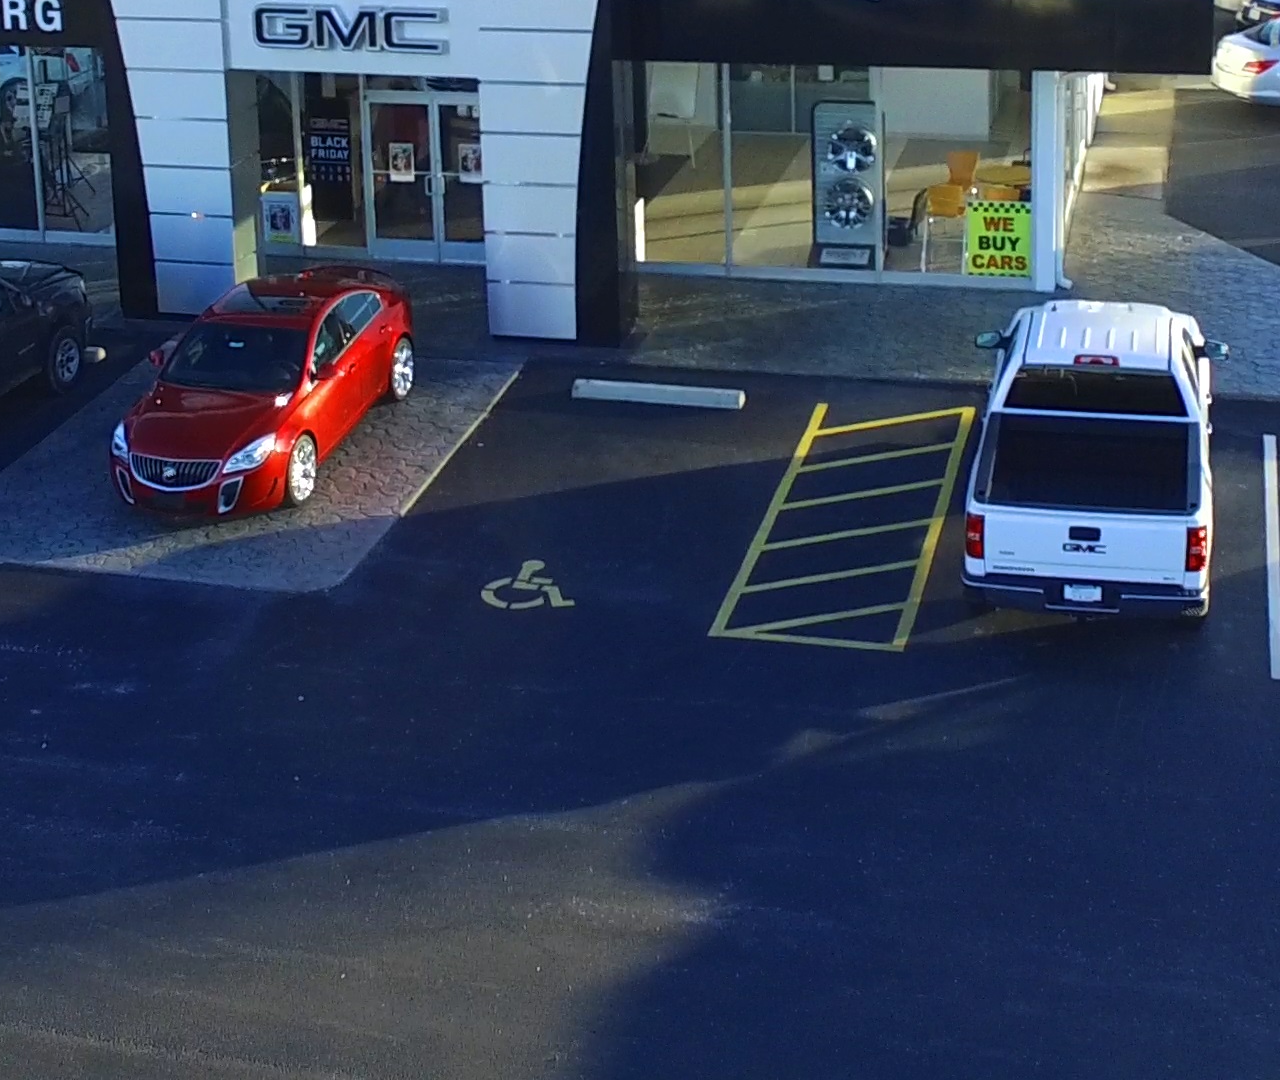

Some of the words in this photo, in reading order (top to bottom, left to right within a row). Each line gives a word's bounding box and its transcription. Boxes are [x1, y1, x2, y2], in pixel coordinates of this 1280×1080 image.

[252, 2, 450, 55] GMC
[310, 135, 349, 148] BLACK
[311, 148, 350, 160] FRIDAY
[982, 216, 1015, 232] WE
[978, 235, 1021, 252] BUY
[971, 254, 1028, 271] CARS
[1062, 542, 1108, 555] GMC
